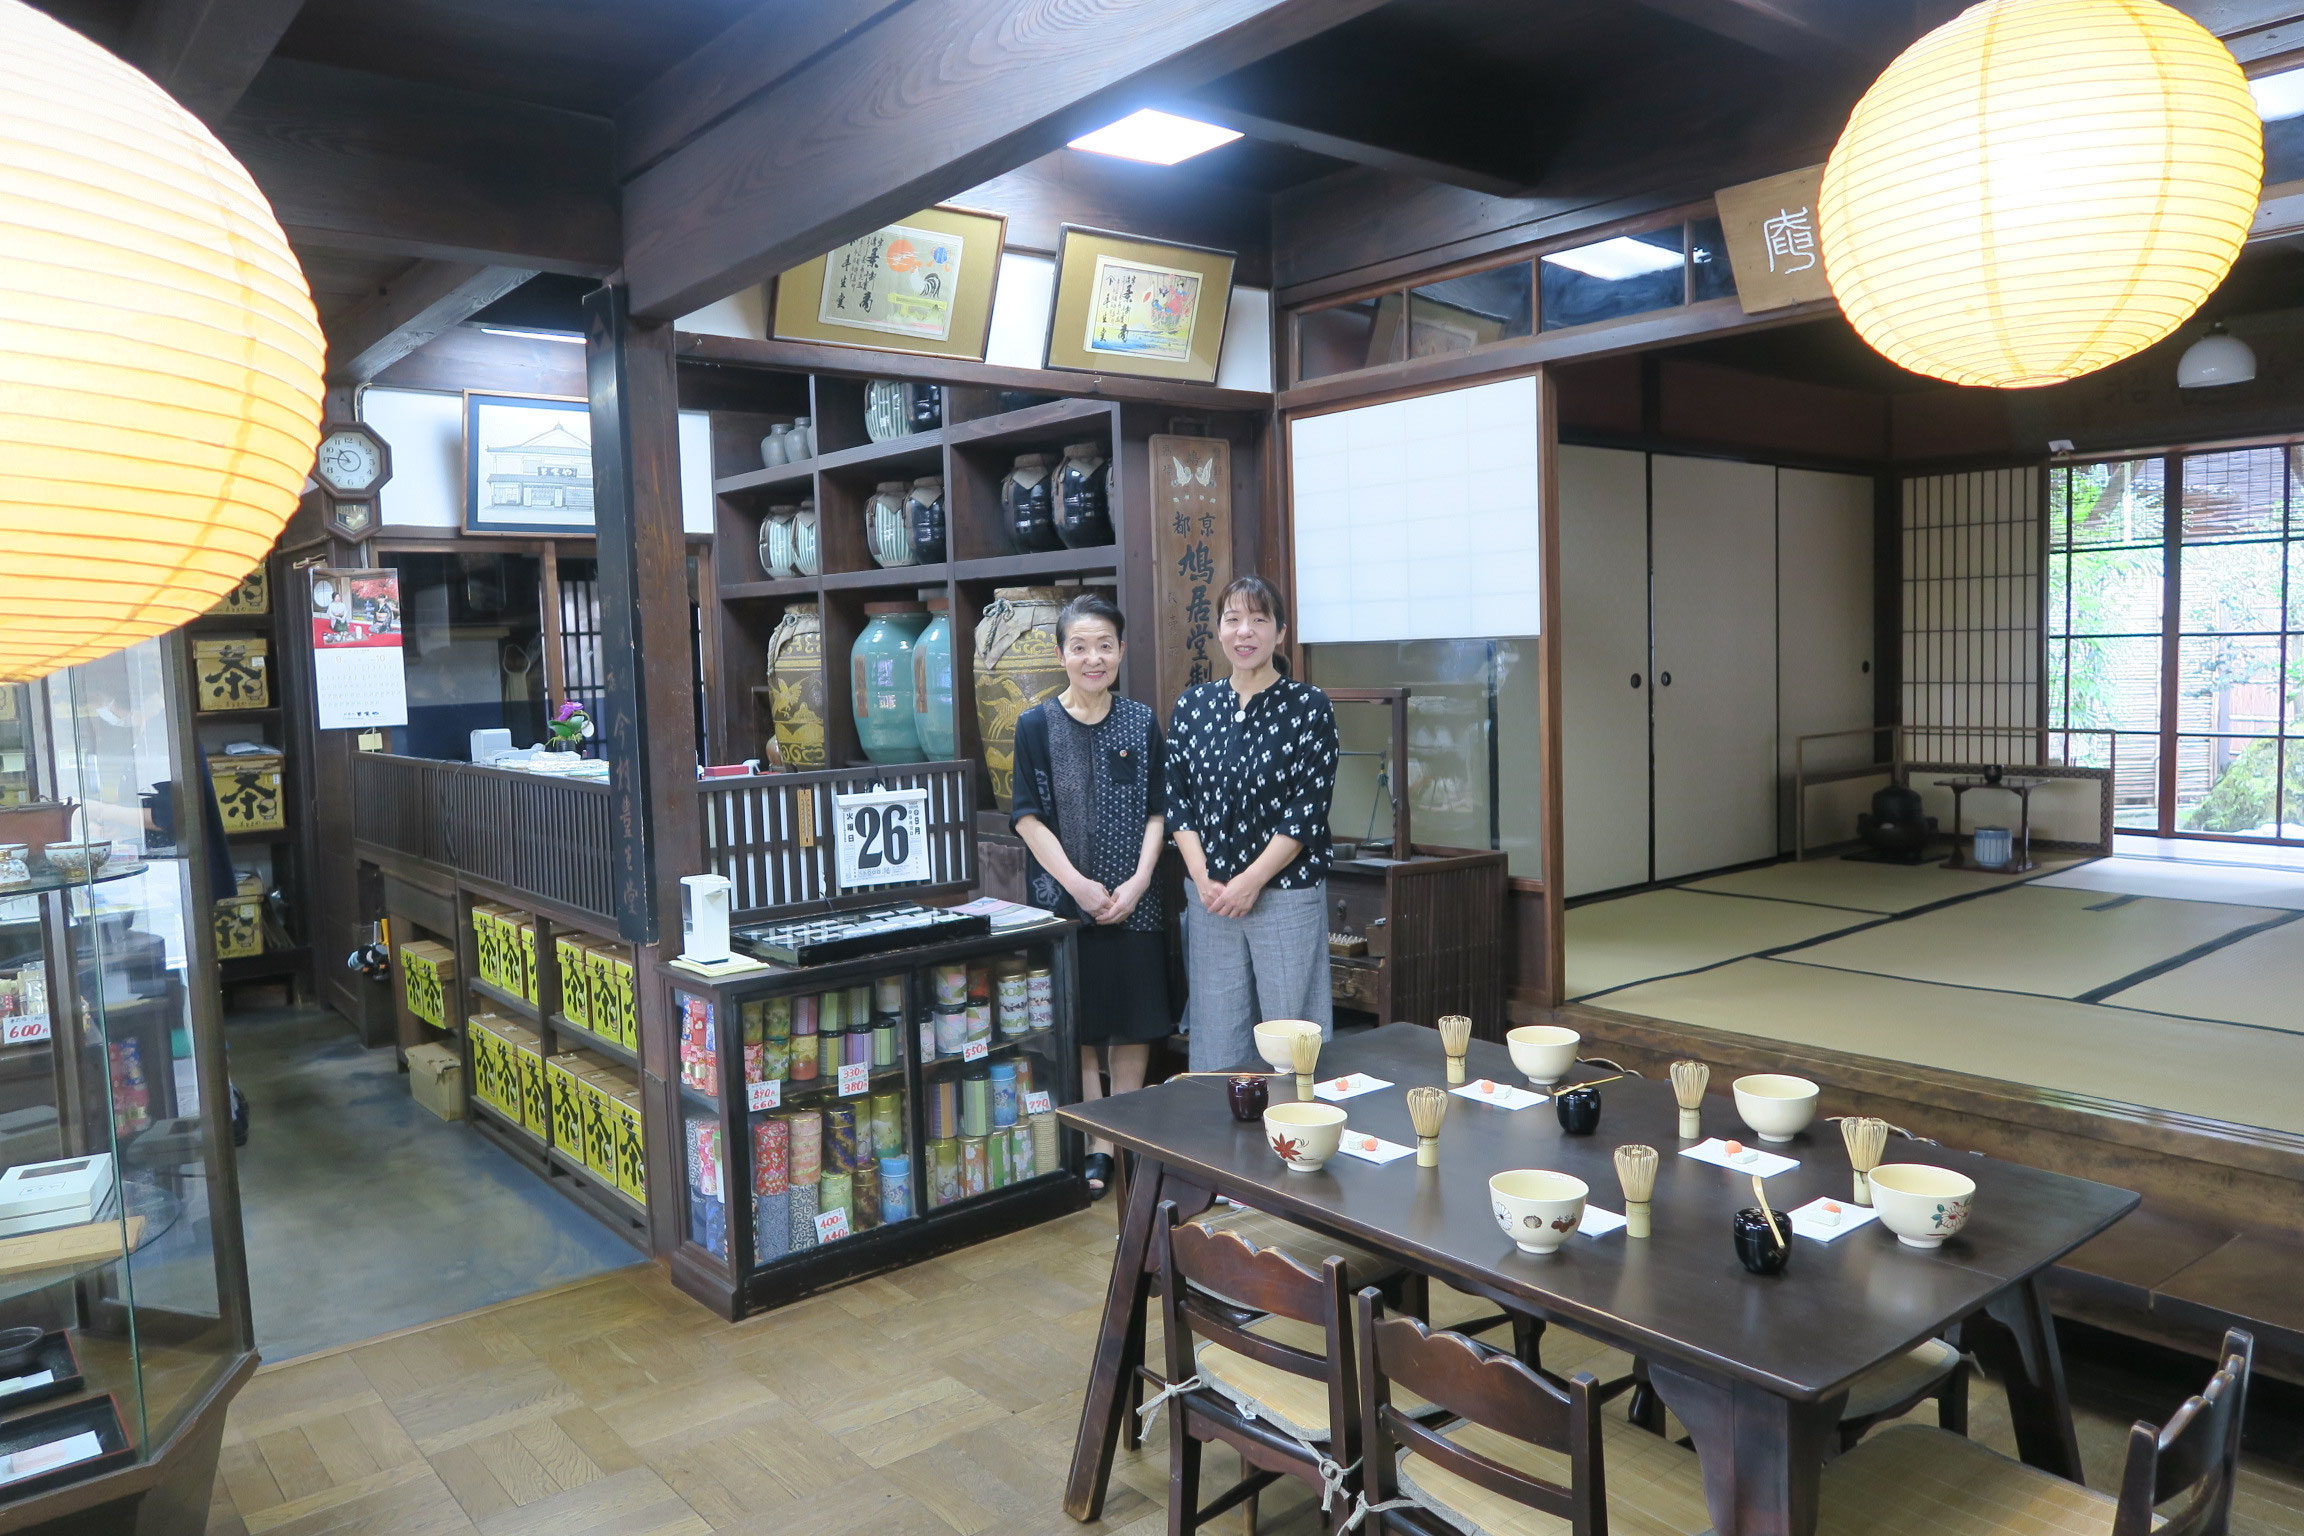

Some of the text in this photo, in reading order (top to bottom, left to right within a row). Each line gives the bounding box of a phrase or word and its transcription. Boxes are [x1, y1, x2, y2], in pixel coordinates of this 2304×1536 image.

[205, 645, 263, 700] 茶
[846, 812, 855, 842] 火曜日
[855, 804, 909, 869] 26
[406, 953, 422, 1007] 茶
[478, 916, 498, 978] 茶
[502, 923, 521, 988] 茶
[423, 962, 444, 1021] 茶
[565, 948, 587, 1019] 茶
[594, 959, 618, 1033] 茶
[476, 1028, 496, 1097] 茶
[497, 1041, 518, 1113] 茶
[525, 1056, 547, 1129] 茶
[555, 1072, 580, 1151] 茶
[588, 1090, 613, 1173] 茶
[620, 1109, 647, 1194] 茶
